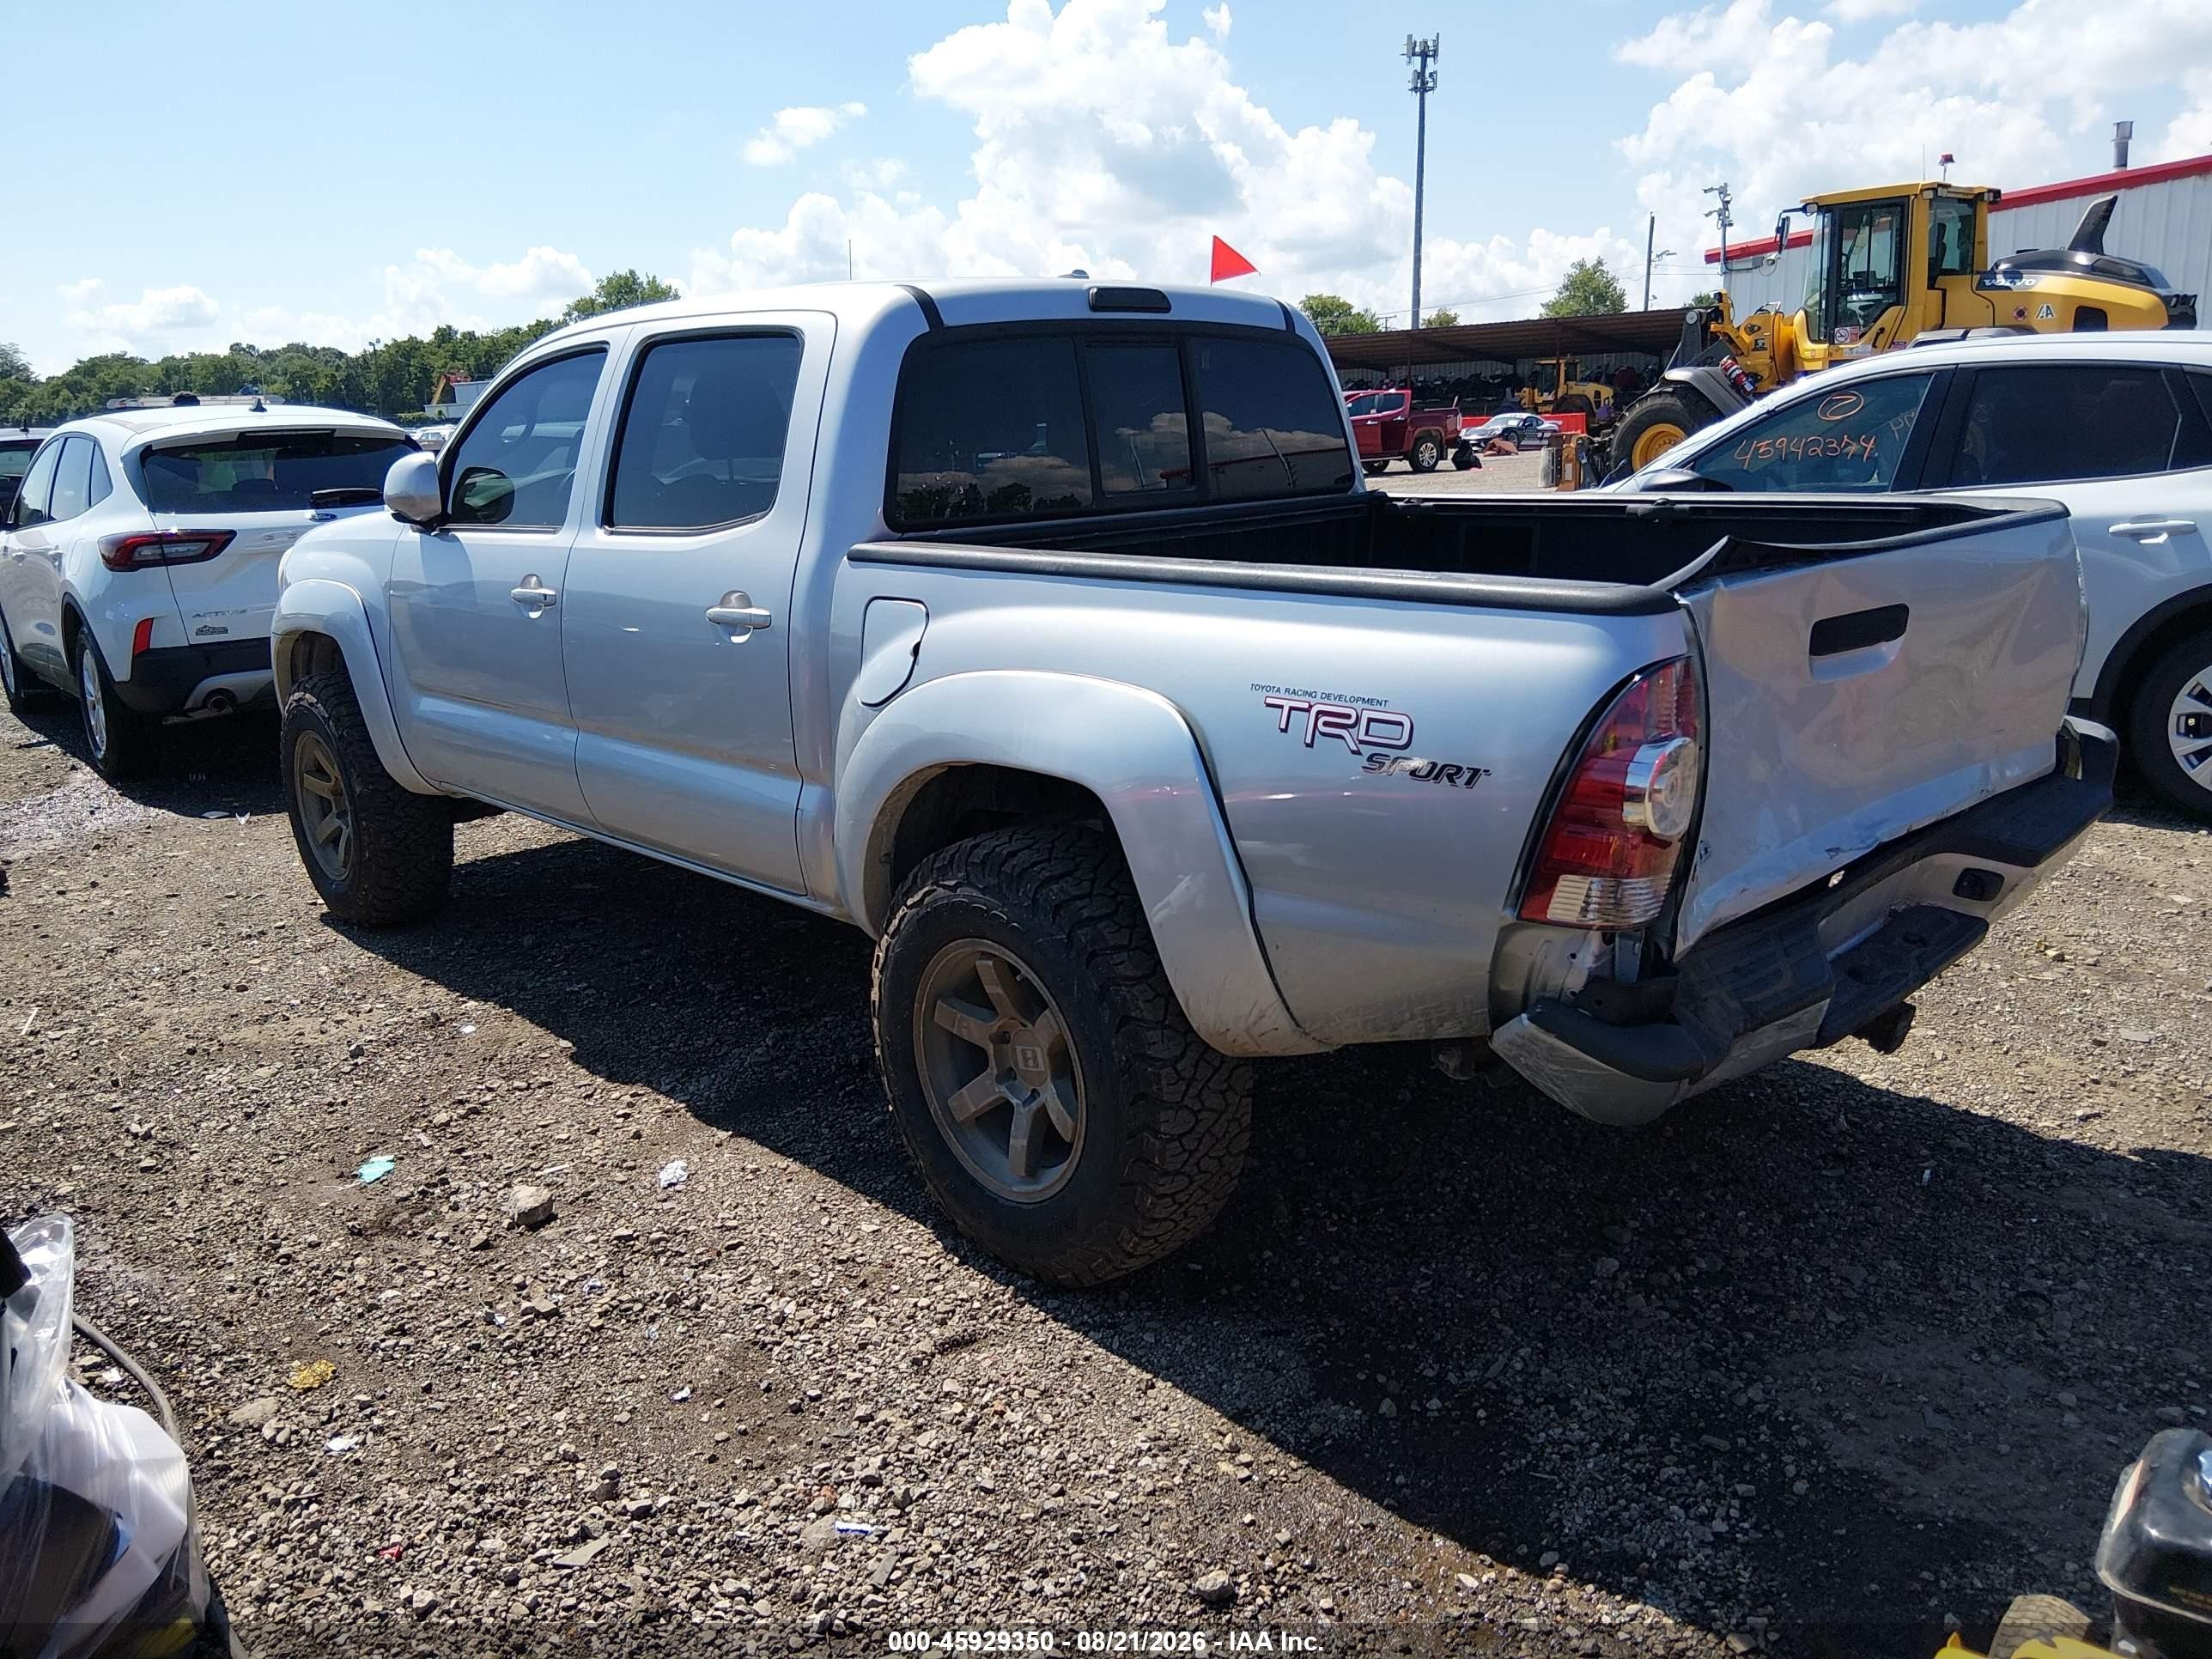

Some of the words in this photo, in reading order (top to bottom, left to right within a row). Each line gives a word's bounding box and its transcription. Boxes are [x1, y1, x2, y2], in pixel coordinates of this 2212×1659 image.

[1250, 683, 1281, 695] TOYOTA
[1284, 688, 1317, 699] RACING
[1320, 692, 1389, 708] DEVELOPMENT
[1264, 696, 1414, 757] TRD
[1361, 752, 1492, 789] SPORT
